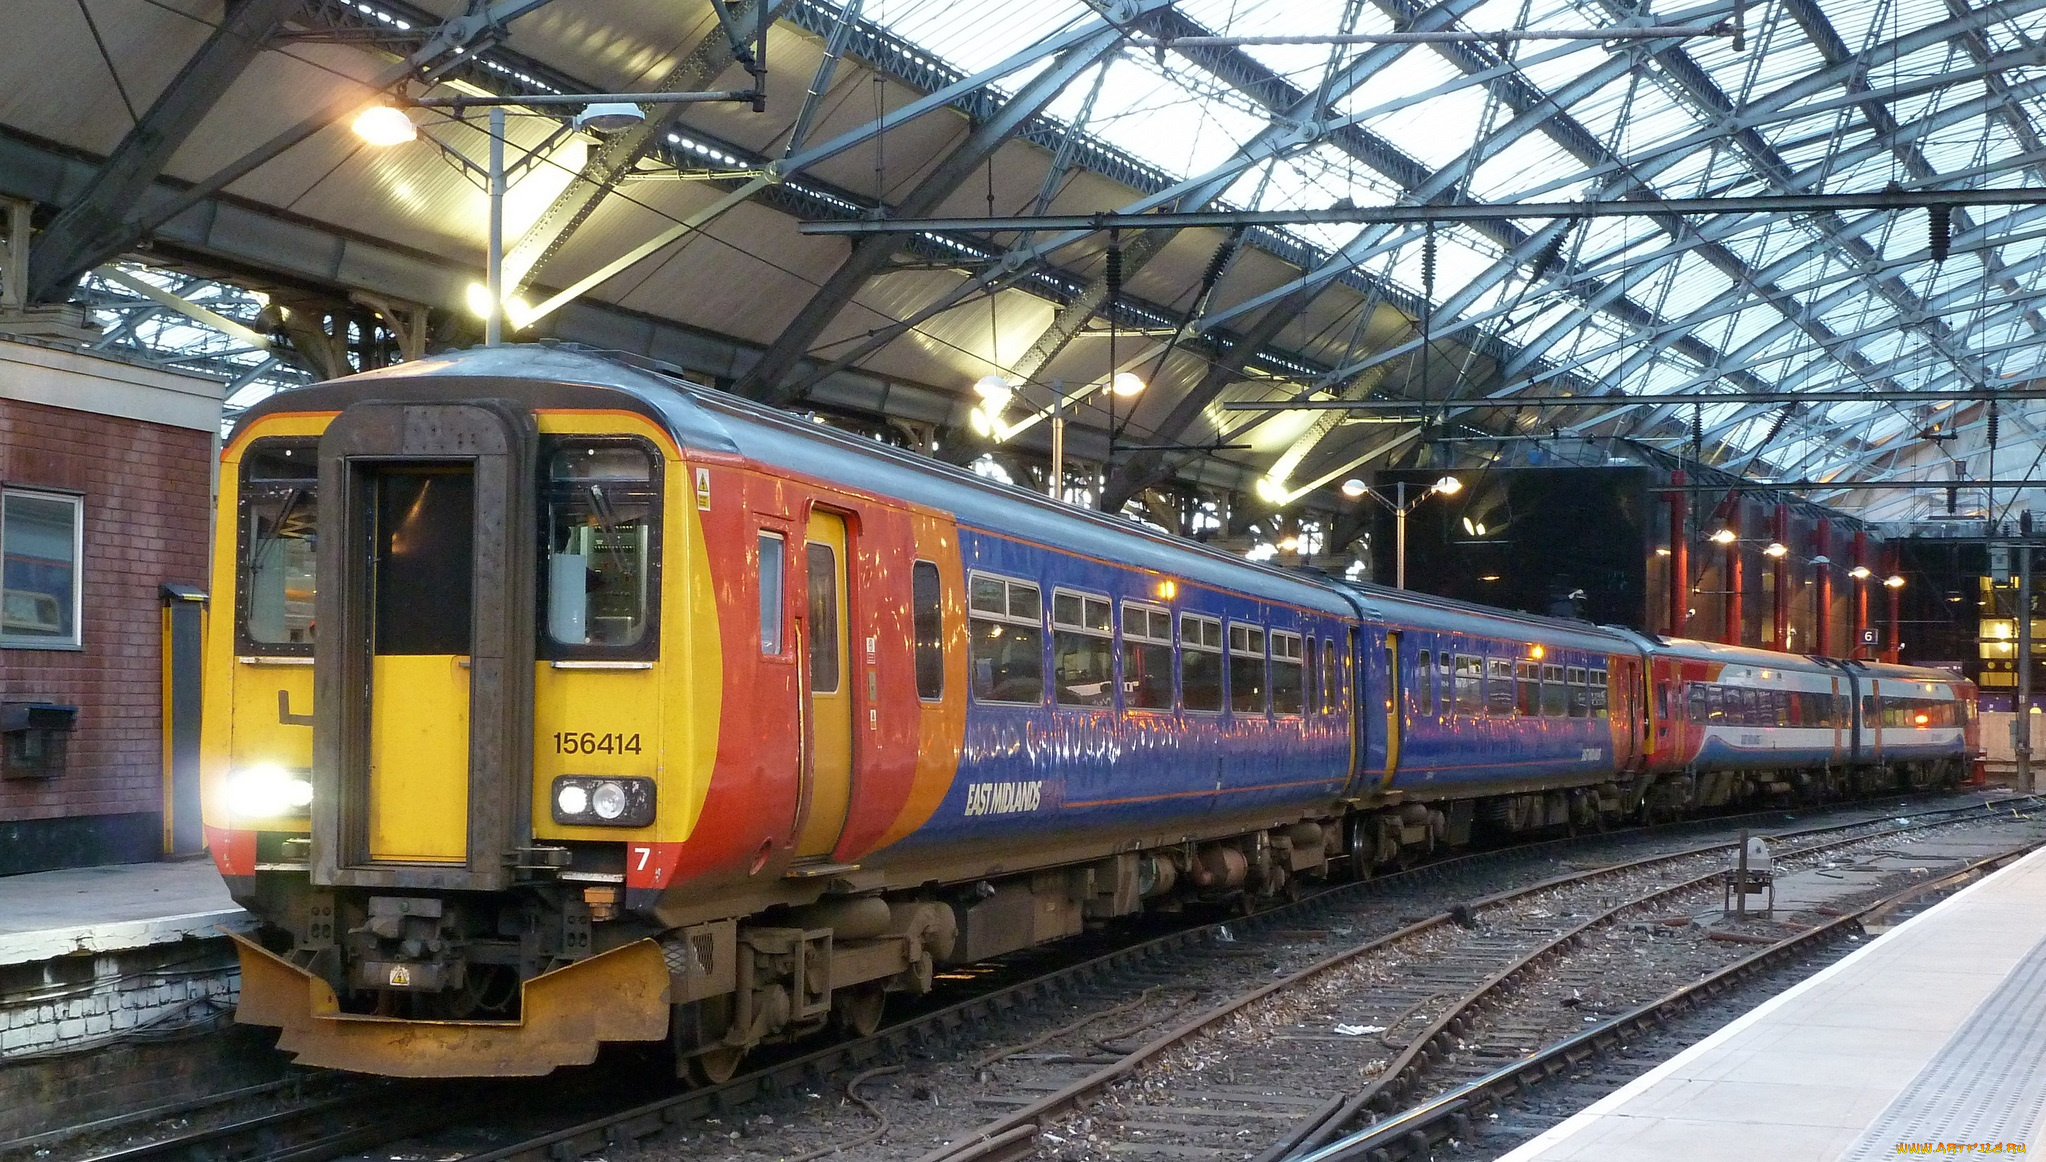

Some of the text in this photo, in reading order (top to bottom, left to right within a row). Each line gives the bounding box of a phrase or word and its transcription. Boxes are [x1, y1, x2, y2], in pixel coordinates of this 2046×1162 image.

[1864, 631, 1873, 642] 6
[553, 732, 642, 755] 156414
[964, 780, 1042, 816] EAST MIDLANDS
[634, 847, 651, 871] 7
